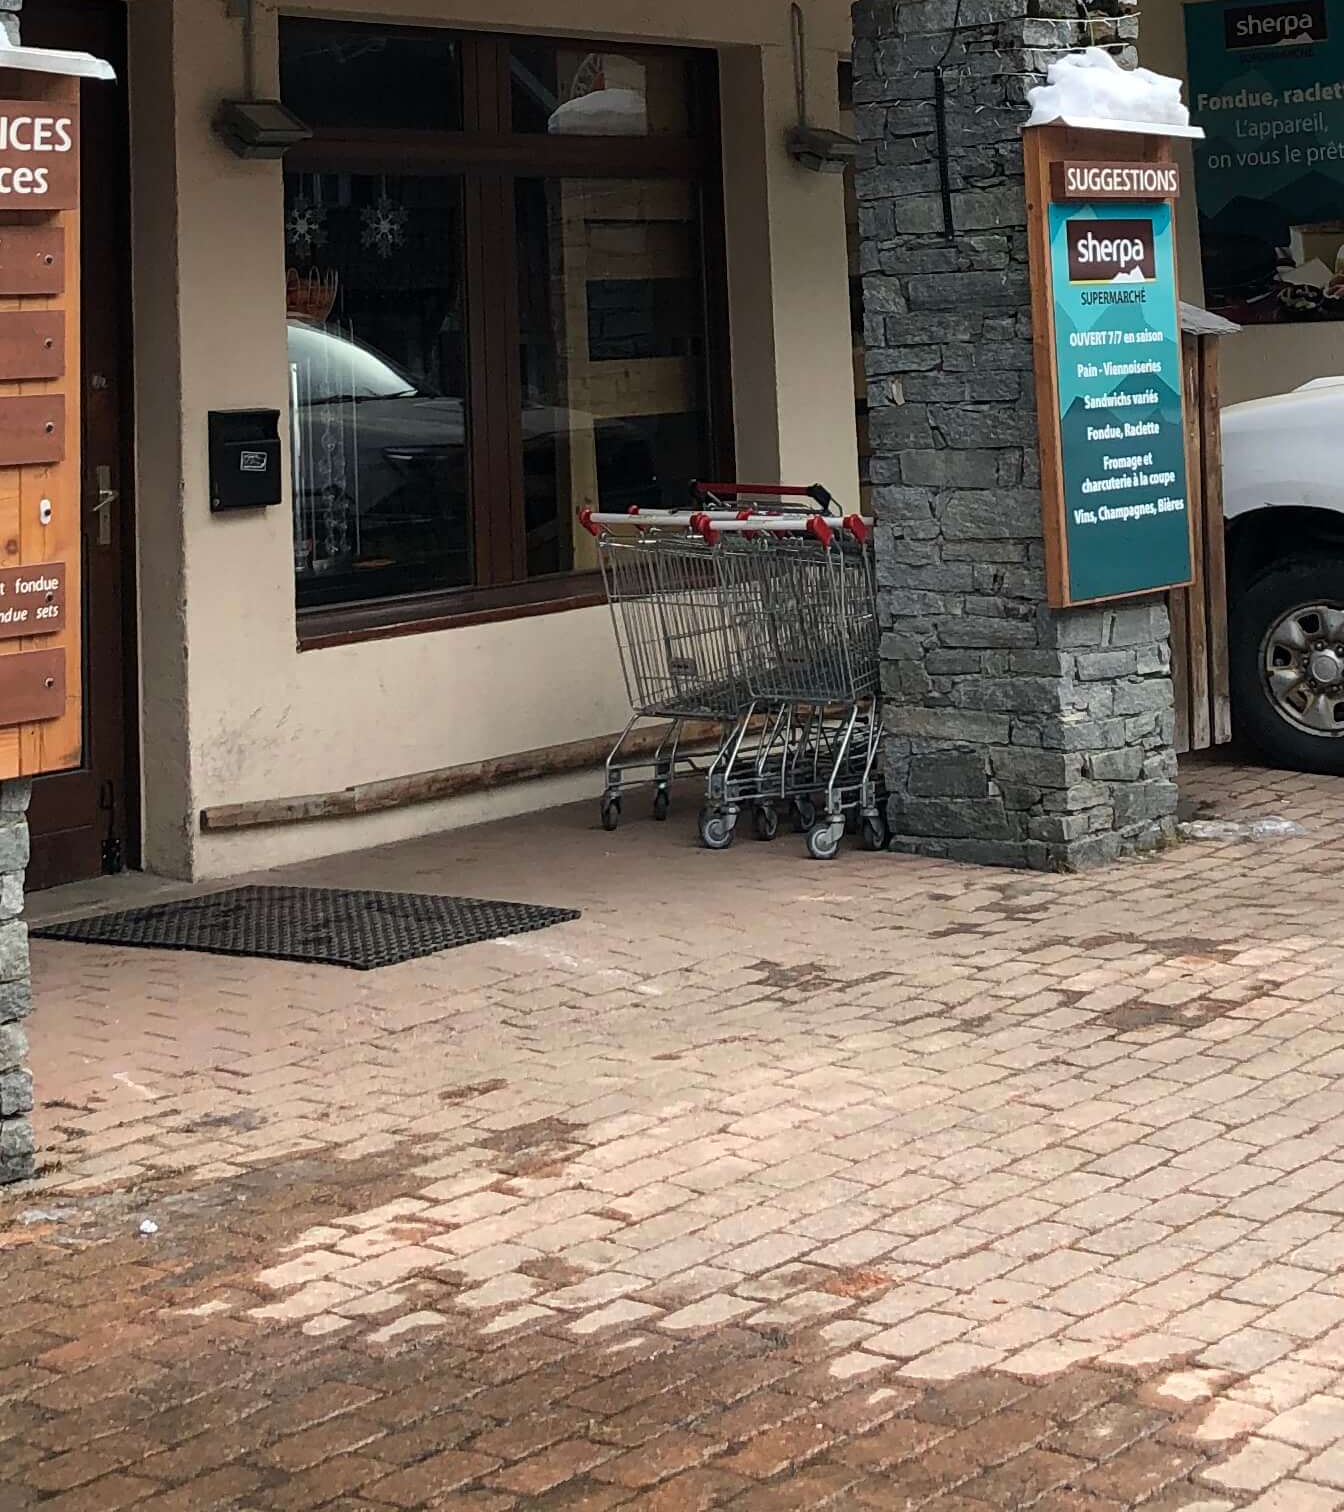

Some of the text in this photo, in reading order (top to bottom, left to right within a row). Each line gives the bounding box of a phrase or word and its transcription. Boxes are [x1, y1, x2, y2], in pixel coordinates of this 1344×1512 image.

[1236, 13, 1313, 36] sherpa
[1197, 91, 1279, 112] Fondue,
[1208, 152, 1231, 169] on
[1237, 149, 1280, 167] vous
[1284, 145, 1301, 164] le
[1068, 167, 1177, 192] SUGGESTIONS
[1077, 232, 1145, 268] sherpa
[1081, 288, 1146, 306] SUPERMARCHÉ
[1069, 328, 1163, 347] OUVERT 7/7 en saison
[1077, 362, 1097, 378] Pain
[1103, 358, 1162, 375] Viennoiseries
[1084, 389, 1159, 410] Sandwichs variés
[1087, 421, 1160, 441] Fondue, Raclette
[1103, 452, 1153, 471] Fromage et
[1081, 469, 1175, 494] charcuterie à la coupe
[1074, 497, 1184, 525] Vins, Champagnes, Bières
[15, 576, 59, 595] fondue
[36, 603, 59, 620] sets
